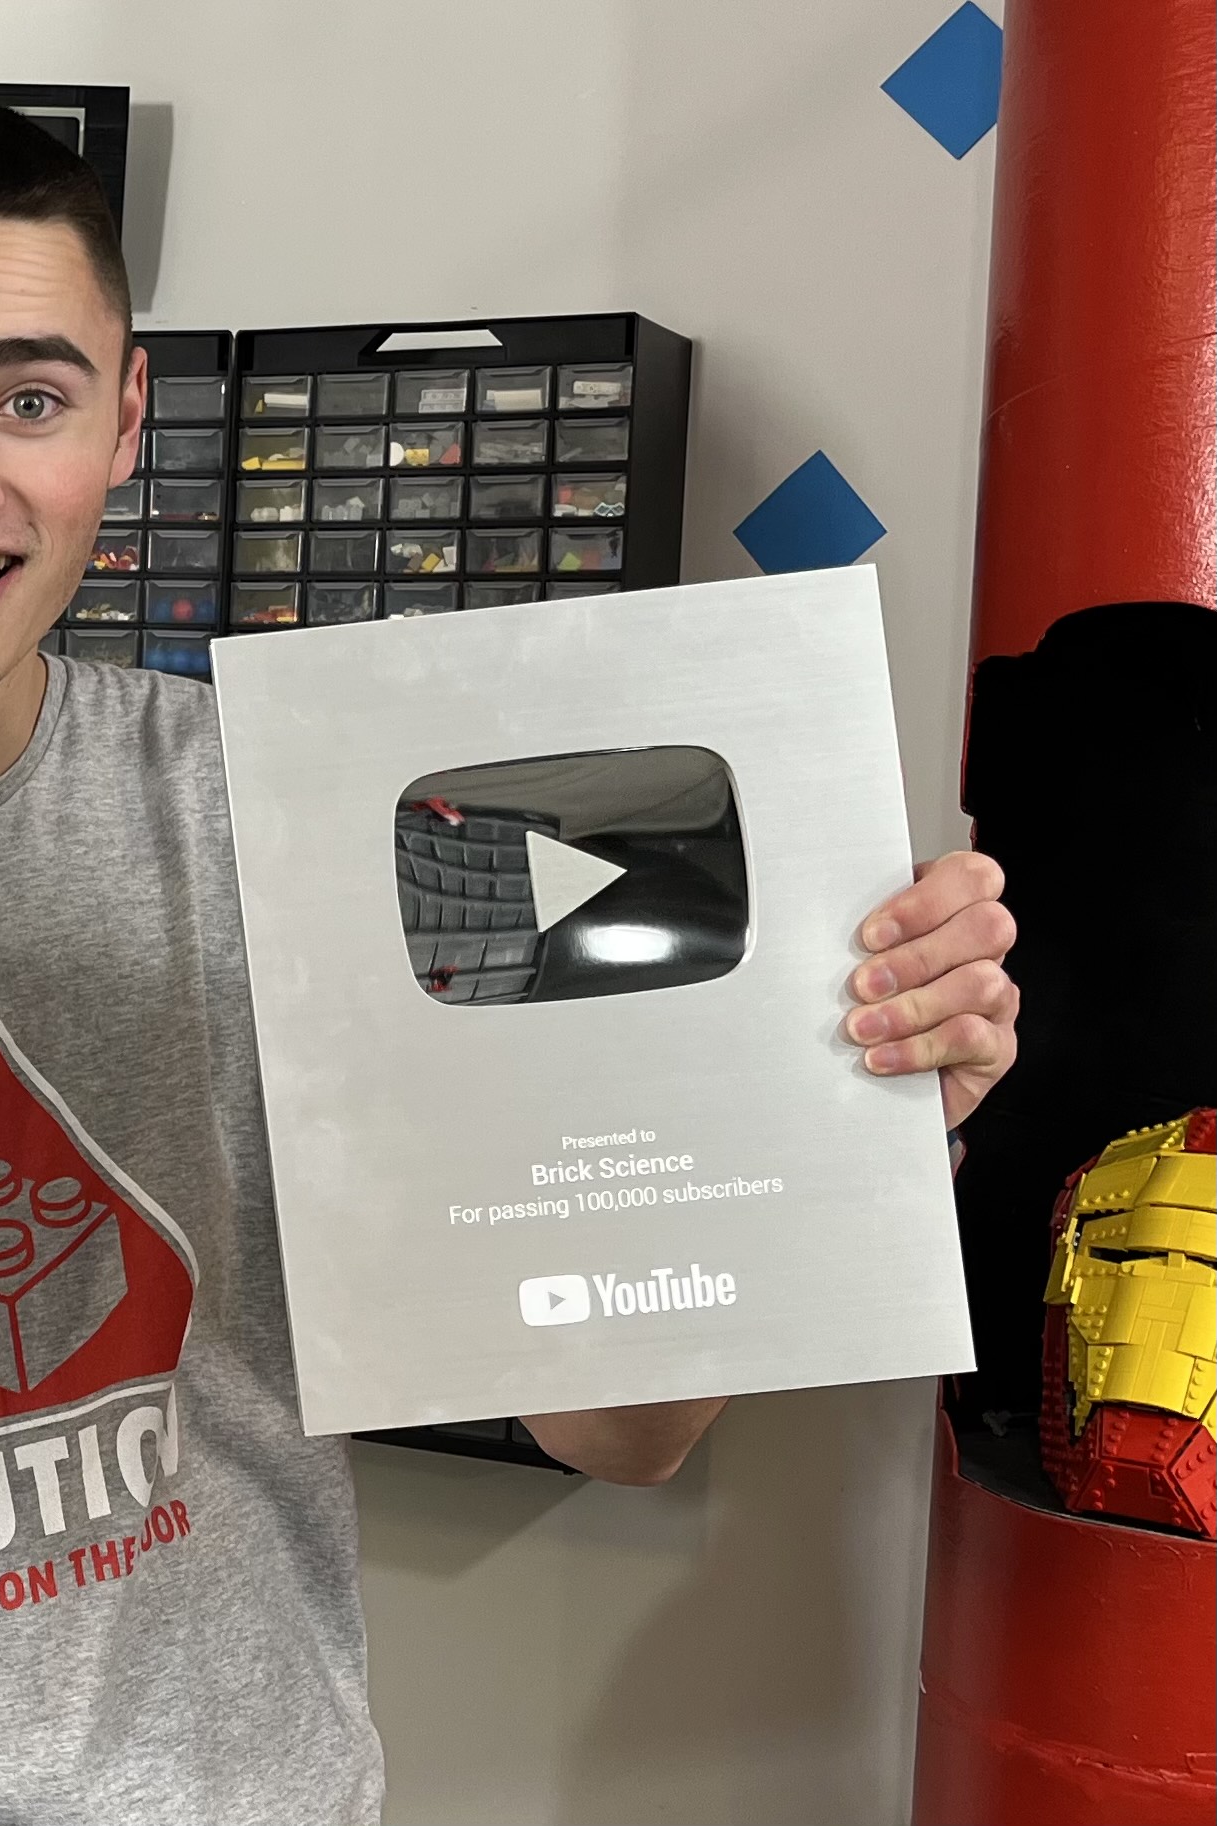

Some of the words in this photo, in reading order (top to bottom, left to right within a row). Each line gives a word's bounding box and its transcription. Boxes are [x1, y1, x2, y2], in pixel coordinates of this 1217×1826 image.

[561, 1130, 637, 1150] Presented
[640, 1129, 656, 1143] to
[531, 1158, 594, 1186] Brick
[599, 1154, 694, 1179] Science
[449, 1205, 482, 1225] For
[488, 1196, 570, 1225] passing
[575, 1186, 657, 1212] 100,000
[662, 1176, 784, 1204] subscribers
[592, 1263, 737, 1317] YouTube
